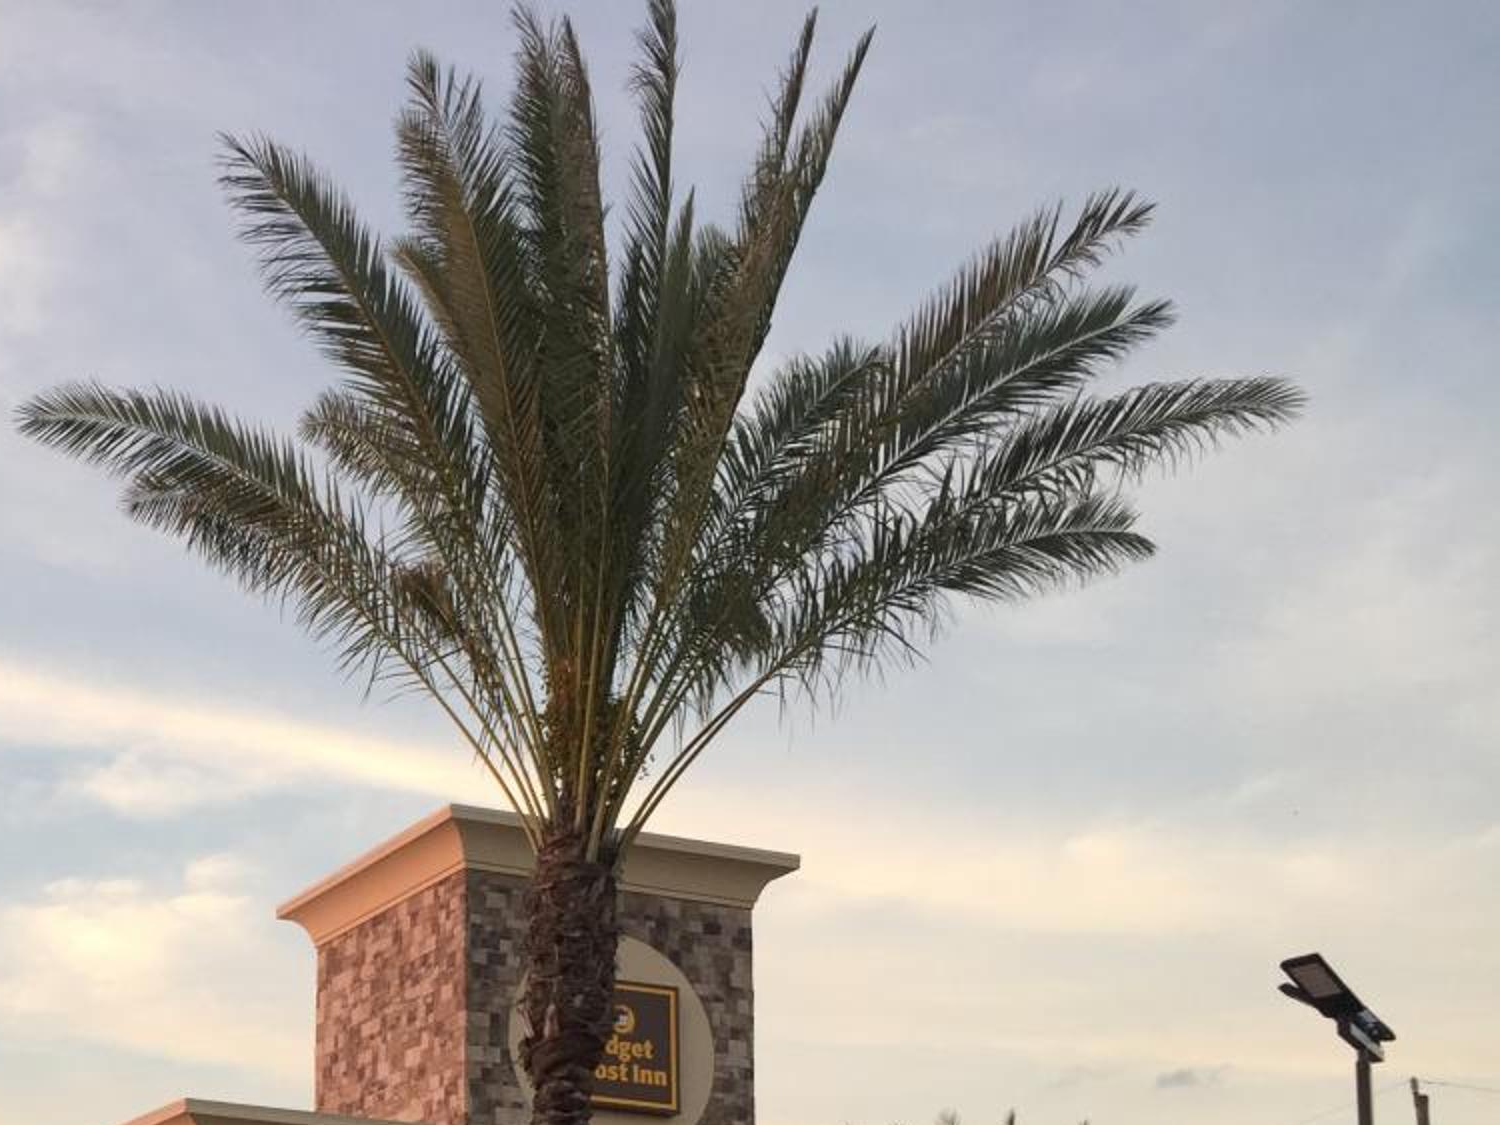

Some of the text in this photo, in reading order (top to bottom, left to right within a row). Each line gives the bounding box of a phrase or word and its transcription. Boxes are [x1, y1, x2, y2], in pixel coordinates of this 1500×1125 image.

[605, 1035, 654, 1062] dget
[595, 1063, 668, 1087] ost Inn
